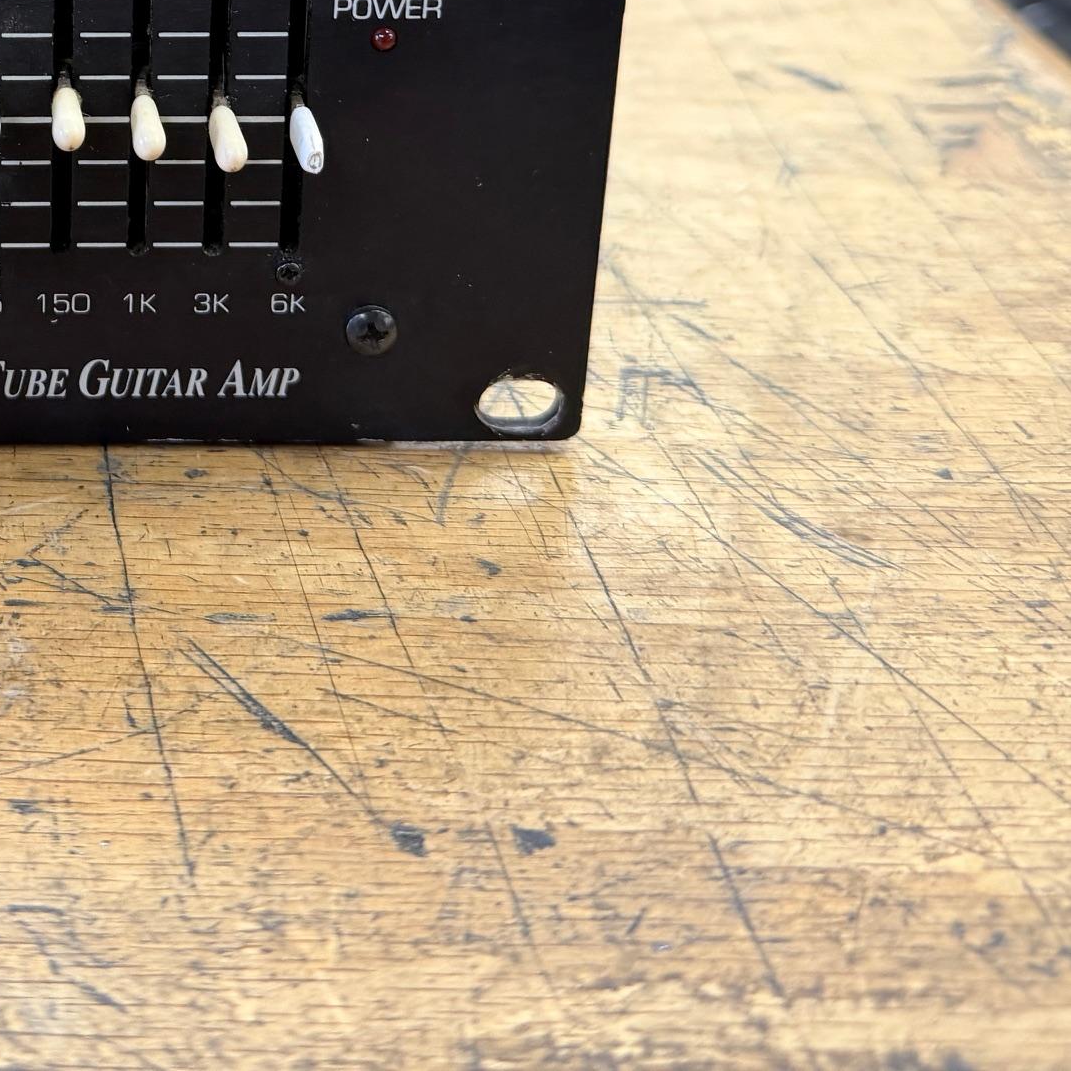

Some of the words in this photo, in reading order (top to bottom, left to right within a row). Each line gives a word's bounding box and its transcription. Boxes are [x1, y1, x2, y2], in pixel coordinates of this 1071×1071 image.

[36, 292, 91, 314] 150
[122, 292, 157, 314] 1K
[193, 292, 230, 314] 3K
[270, 292, 306, 314] 6K
[78, 357, 208, 399] GUITAR
[216, 358, 300, 399] AMP
